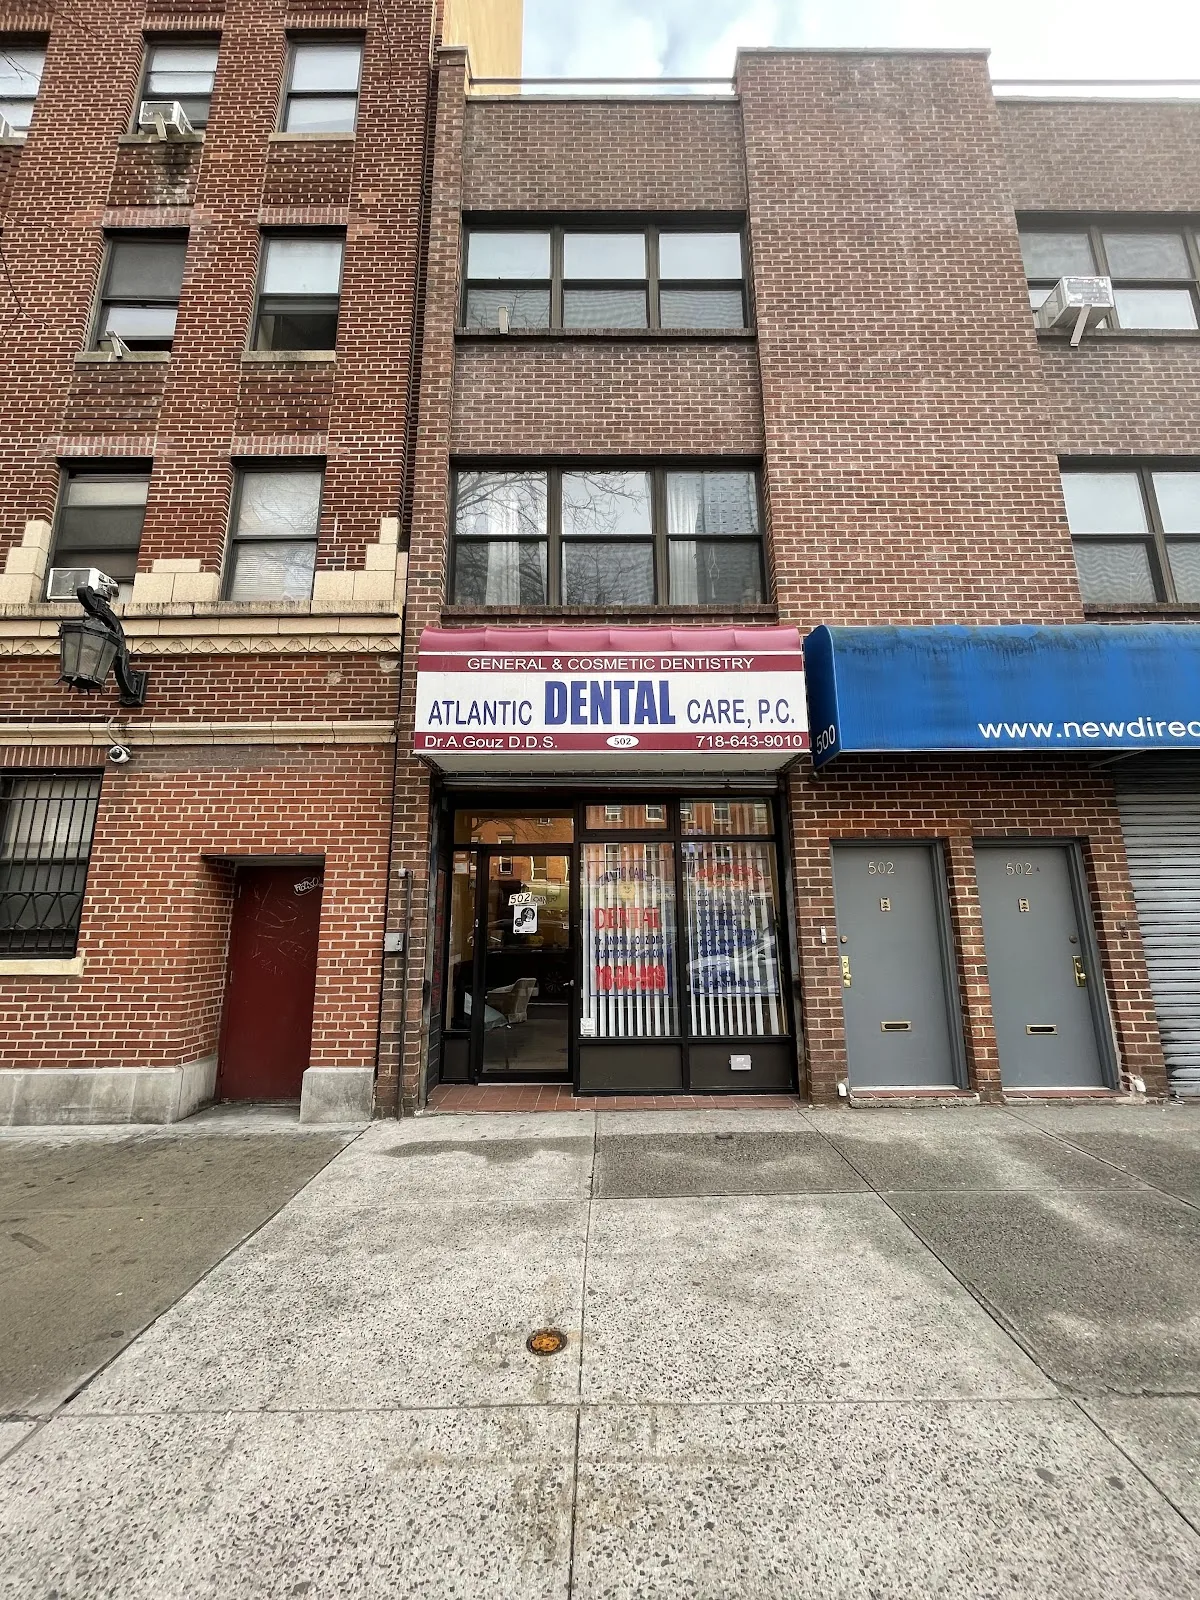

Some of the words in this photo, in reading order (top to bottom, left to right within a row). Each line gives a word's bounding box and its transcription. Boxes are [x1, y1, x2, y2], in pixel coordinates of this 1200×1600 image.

[467, 658, 547, 671] GENERAL
[551, 658, 564, 670] &
[567, 658, 655, 670] COSMETIC
[660, 657, 754, 670] DENTISTRY
[428, 700, 533, 726] ATLANTIC
[544, 680, 676, 725] DENTAL
[686, 698, 751, 728] CARE,
[758, 698, 795, 724] P.C.
[978, 716, 1200, 738] www.newdirec
[508, 735, 558, 748] D.D.S.
[613, 737, 632, 746] 502
[695, 734, 802, 748] 718-643-9010
[816, 724, 836, 755] 500
[868, 861, 895, 875] 502
[1006, 862, 1033, 876] 502
[511, 893, 531, 903] 502
[594, 907, 662, 929] DENTAL
